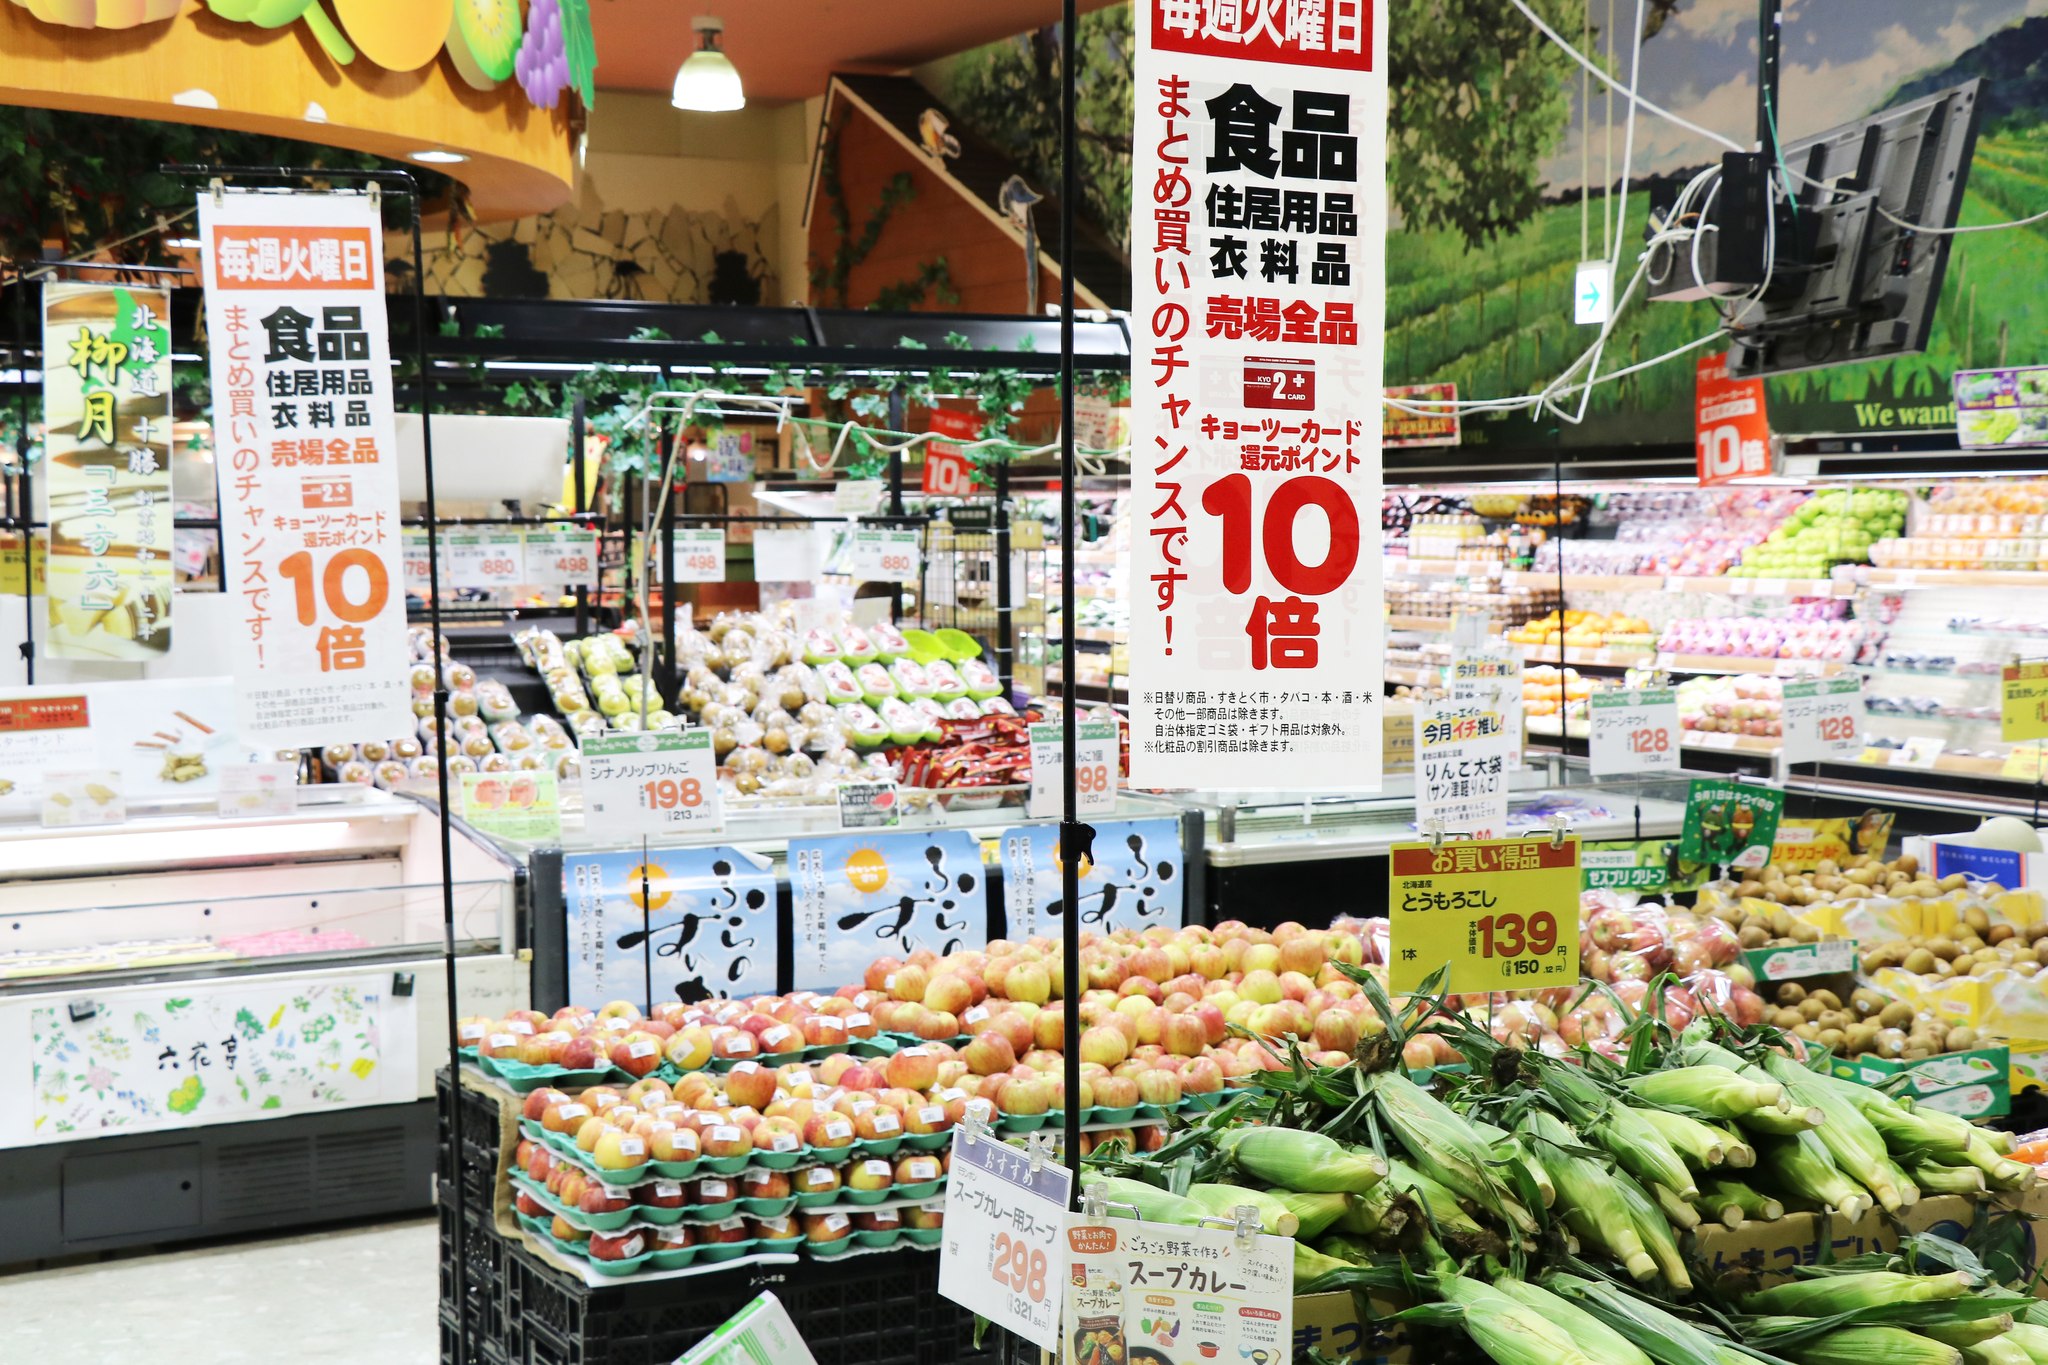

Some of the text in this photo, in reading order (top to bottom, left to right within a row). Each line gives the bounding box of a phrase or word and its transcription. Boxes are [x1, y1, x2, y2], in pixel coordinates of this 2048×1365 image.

[1159, 0, 1363, 54] 毎週火曜日
[1205, 83, 1358, 182] 食品
[1205, 183, 1358, 236] 住居用品
[218, 236, 368, 284] 毎週火曜日
[1209, 235, 1351, 286] 衣料品
[260, 305, 371, 363] 食品
[1205, 294, 1358, 345] 売場全品
[131, 303, 161, 397] 北海道
[1150, 75, 1193, 656] まとめ買いのチャンスです！
[69, 327, 128, 445] 柳月
[266, 369, 373, 398] 住居用品
[1287, 393, 1306, 401] CARD
[271, 400, 372, 430] 衣料品
[1854, 402, 1895, 427] We
[1897, 401, 1957, 425] want
[1201, 414, 1362, 445] キョーツーカード
[128, 416, 161, 475] 十勝
[271, 437, 379, 466] 売場全品
[1240, 445, 1361, 473] 還元ポイント
[223, 304, 272, 669] まとめ買いのチャンスです！
[274, 510, 387, 532] キョーツーカード
[1201, 473, 1360, 596] 10
[303, 529, 387, 548] 還元ポイント
[482, 559, 515, 575] 880
[557, 557, 589, 572] 498
[882, 556, 909, 571] 880
[278, 548, 390, 627] 10
[1245, 595, 1321, 671] 倍
[315, 624, 367, 673] 倍
[1154, 707, 1285, 721] その他一部商品は除きます。
[1436, 706, 1482, 720] キョーエイの
[1596, 715, 1648, 728] グリーンキウイ
[1155, 724, 1347, 737] 自治体指定ゴミ袋・ギフト用品は対象外。
[1423, 715, 1505, 744] 今月イチ推し！
[1631, 727, 1669, 753] 128
[1819, 715, 1855, 741] 128
[590, 761, 690, 780] シナノリップりんご
[1038, 749, 1104, 765] サン津んご1個
[1425, 755, 1502, 782] りんご大袋
[644, 777, 703, 810] 198
[673, 810, 692, 821] 213
[1431, 843, 1541, 874] お買い得品
[1126, 834, 1174, 933] ふら
[1402, 880, 1433, 889] 北海道産
[1588, 868, 1666, 886] ゼスプリ グリーン
[1401, 889, 1497, 913] とうもろこし
[711, 859, 766, 982] ふらの
[1468, 910, 1567, 959] 本体価格 139 円
[1401, 948, 1417, 961] 1本
[1513, 959, 1540, 975] 150
[158, 1034, 238, 1071] 六花亭
[984, 1147, 1034, 1187] おすすめ
[953, 1180, 1058, 1245] スープカレー用スープ
[1071, 1230, 1113, 1240] 野菜とお肉で
[1078, 1241, 1110, 1251] かんたん！
[1130, 1235, 1219, 1260] ごろごろ野菜で作る
[991, 1231, 1048, 1304] 298
[1128, 1261, 1247, 1293] スープカレー
[1247, 1259, 1280, 1274] スパイス香る
[1013, 1297, 1033, 1321] 321
[1076, 1297, 1121, 1310] スープカレー
